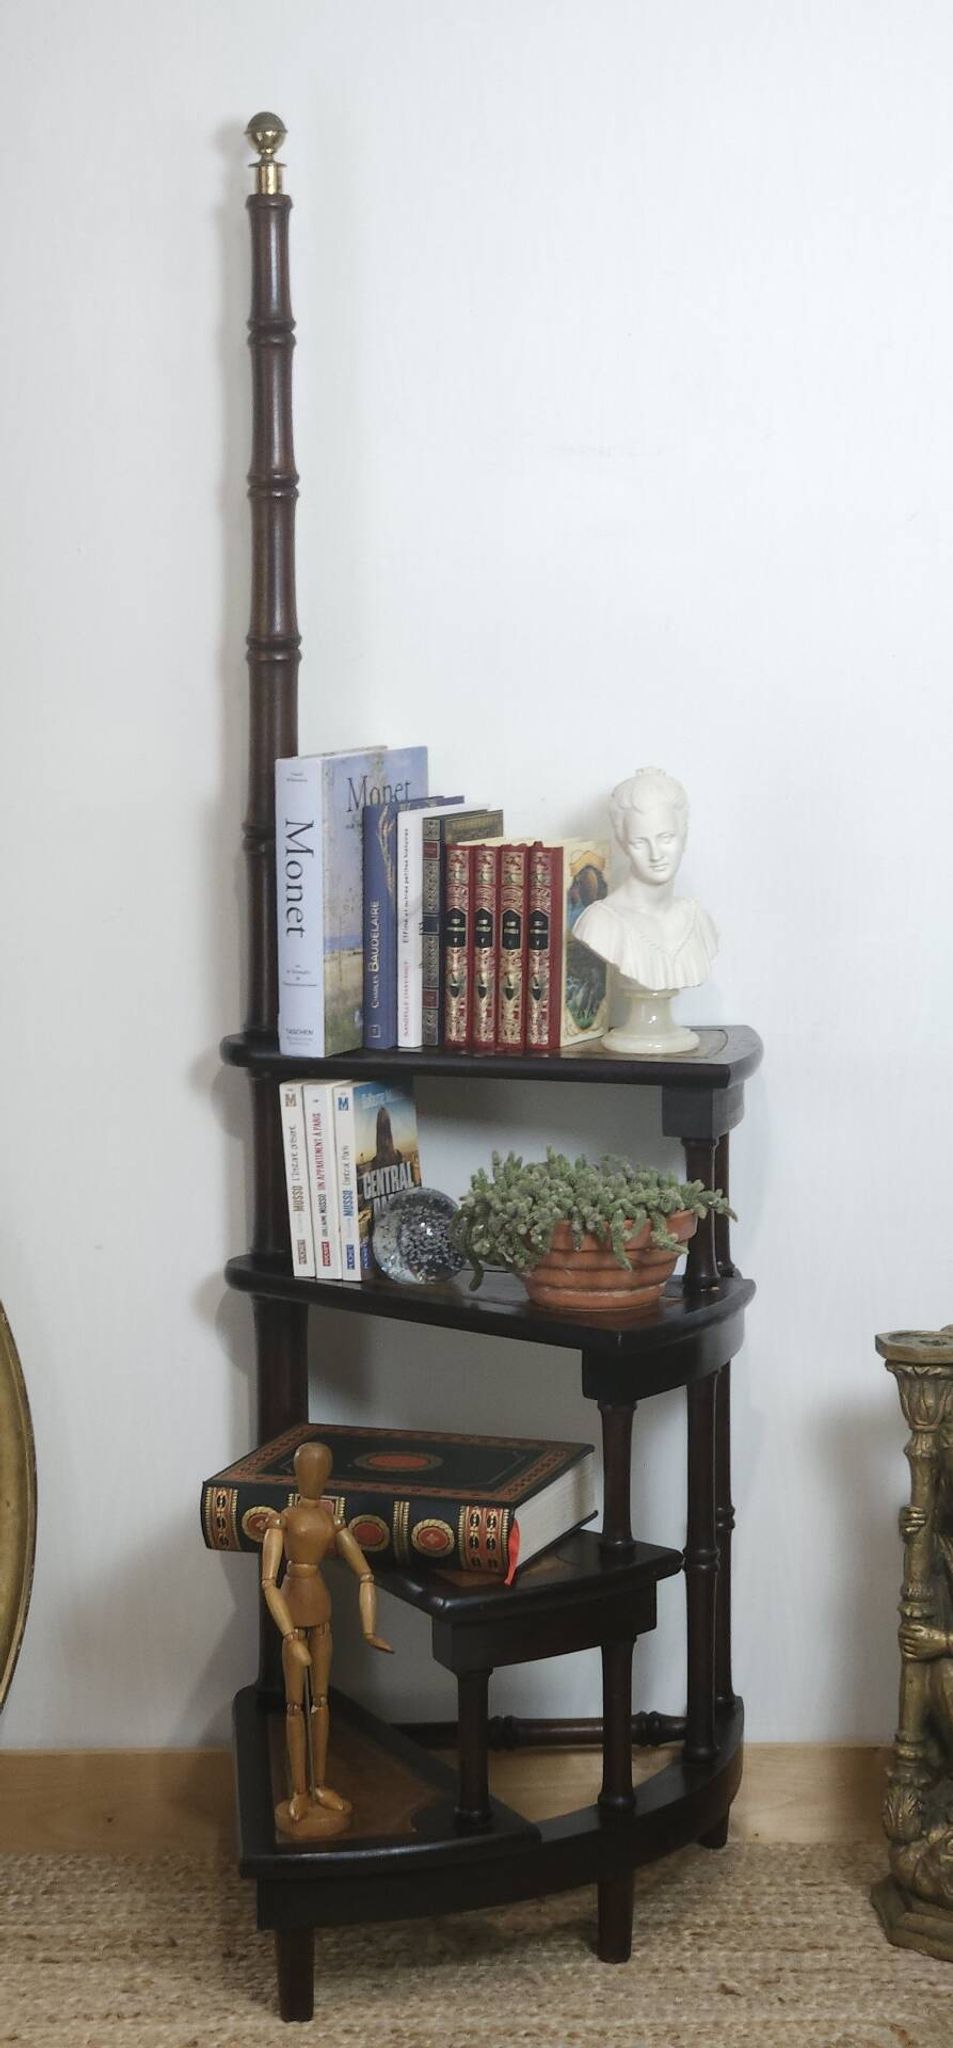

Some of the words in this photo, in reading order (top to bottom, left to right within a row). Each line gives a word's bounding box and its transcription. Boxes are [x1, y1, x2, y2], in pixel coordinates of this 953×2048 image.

[285, 819, 314, 938] Monet
[368, 900, 380, 972] BAUDELAIRE
[338, 1096, 349, 1111] M
[362, 1160, 415, 1200] CENTRAL
[291, 1185, 305, 1212] MUSSO
[317, 1193, 328, 1214] MUSSO
[341, 1190, 355, 1217] MUSSO
